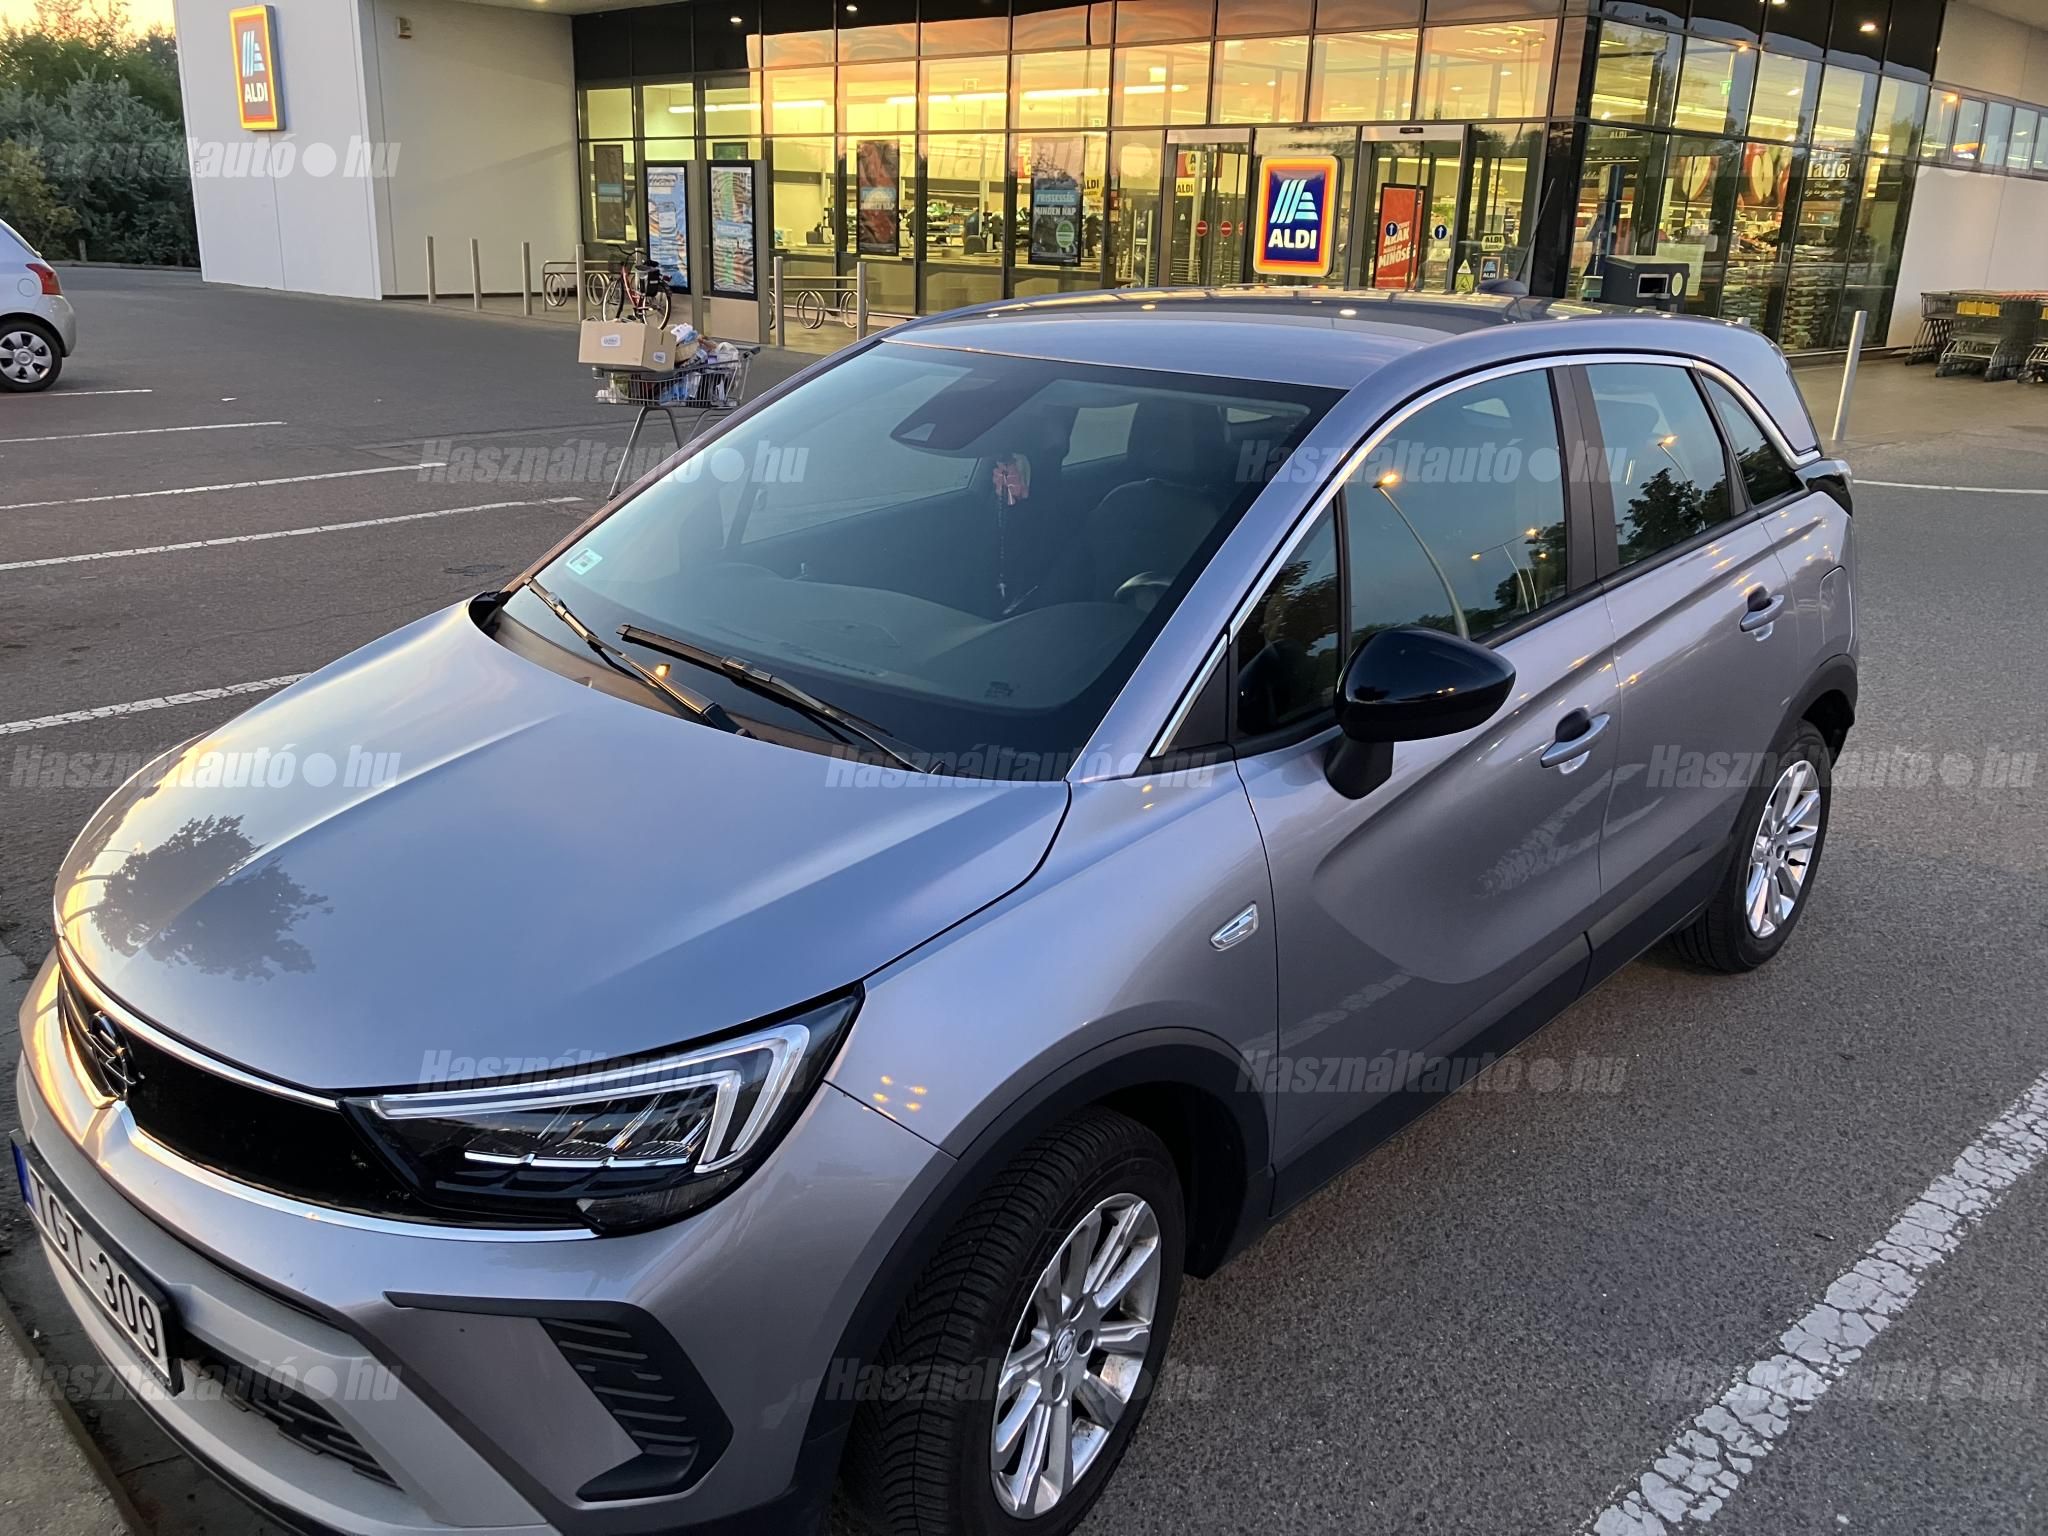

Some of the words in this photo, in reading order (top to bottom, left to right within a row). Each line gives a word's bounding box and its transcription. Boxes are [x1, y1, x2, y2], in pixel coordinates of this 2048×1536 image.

[245, 82, 268, 102] ALDI
[1268, 228, 1317, 249] ALDI
[30, 1166, 159, 1358] TGT-309
